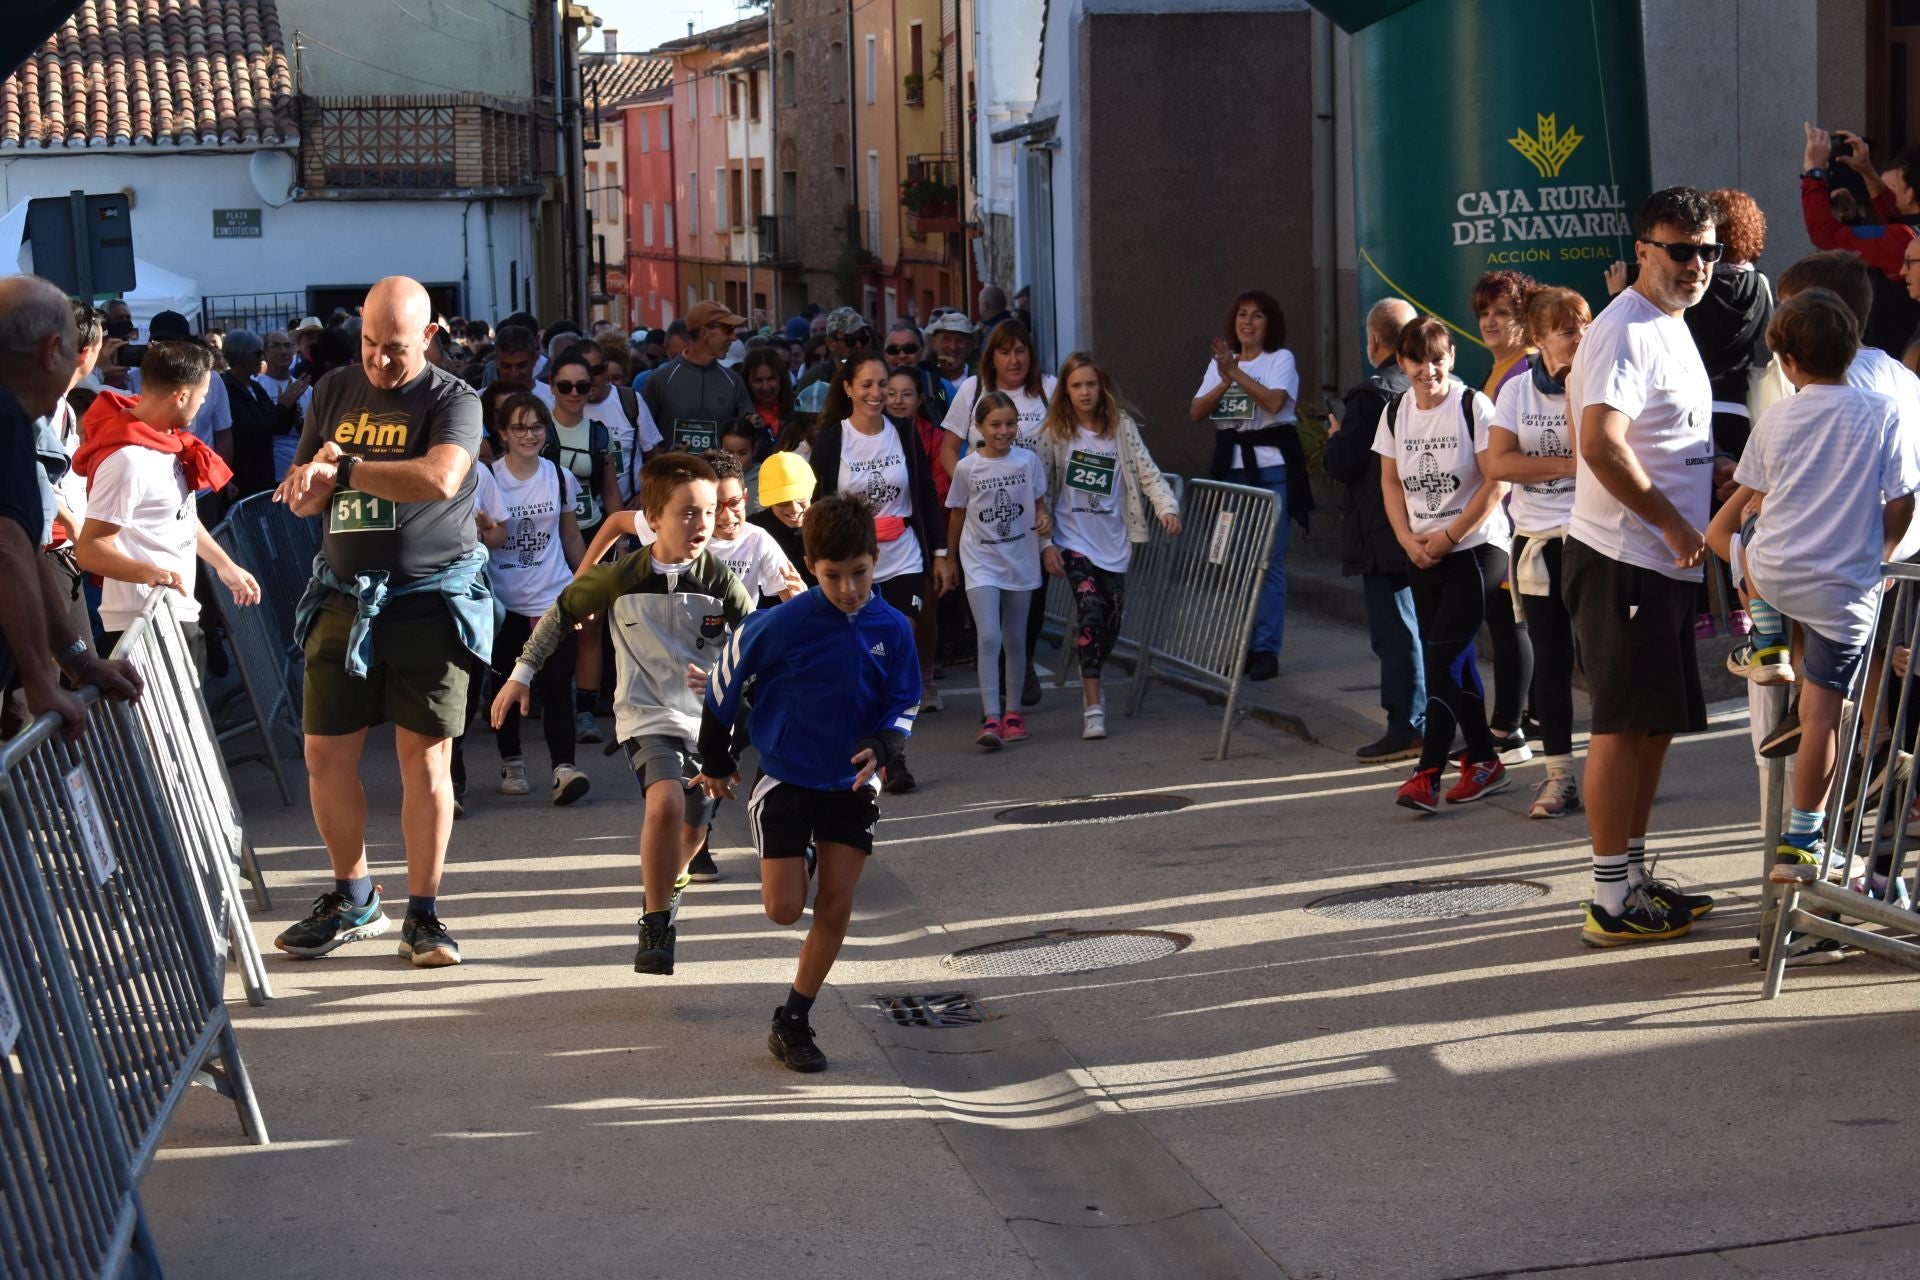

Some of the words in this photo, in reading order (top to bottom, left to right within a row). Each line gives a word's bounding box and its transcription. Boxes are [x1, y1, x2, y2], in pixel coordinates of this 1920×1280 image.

[1457, 188, 1534, 218] CAJA
[1538, 184, 1626, 212] RURAL
[226, 211, 248, 220] PLAZA
[1452, 218, 1496, 246] DE
[1501, 212, 1632, 242] NAVARRA
[1487, 247, 1550, 265] ACCIÓN
[1559, 247, 1613, 261] SOCIAL
[1219, 399, 1247, 413] 354
[1522, 412, 1568, 420] CARRERA-MA
[335, 413, 408, 446] ehm
[682, 435, 711, 448] 569
[849, 454, 900, 468] CARRERA-MRCHA
[850, 459, 901, 473] SOLIDARIA
[976, 478, 1026, 491] SOLIDARIA
[1073, 468, 1107, 488] 254
[338, 498, 379, 520] 511
